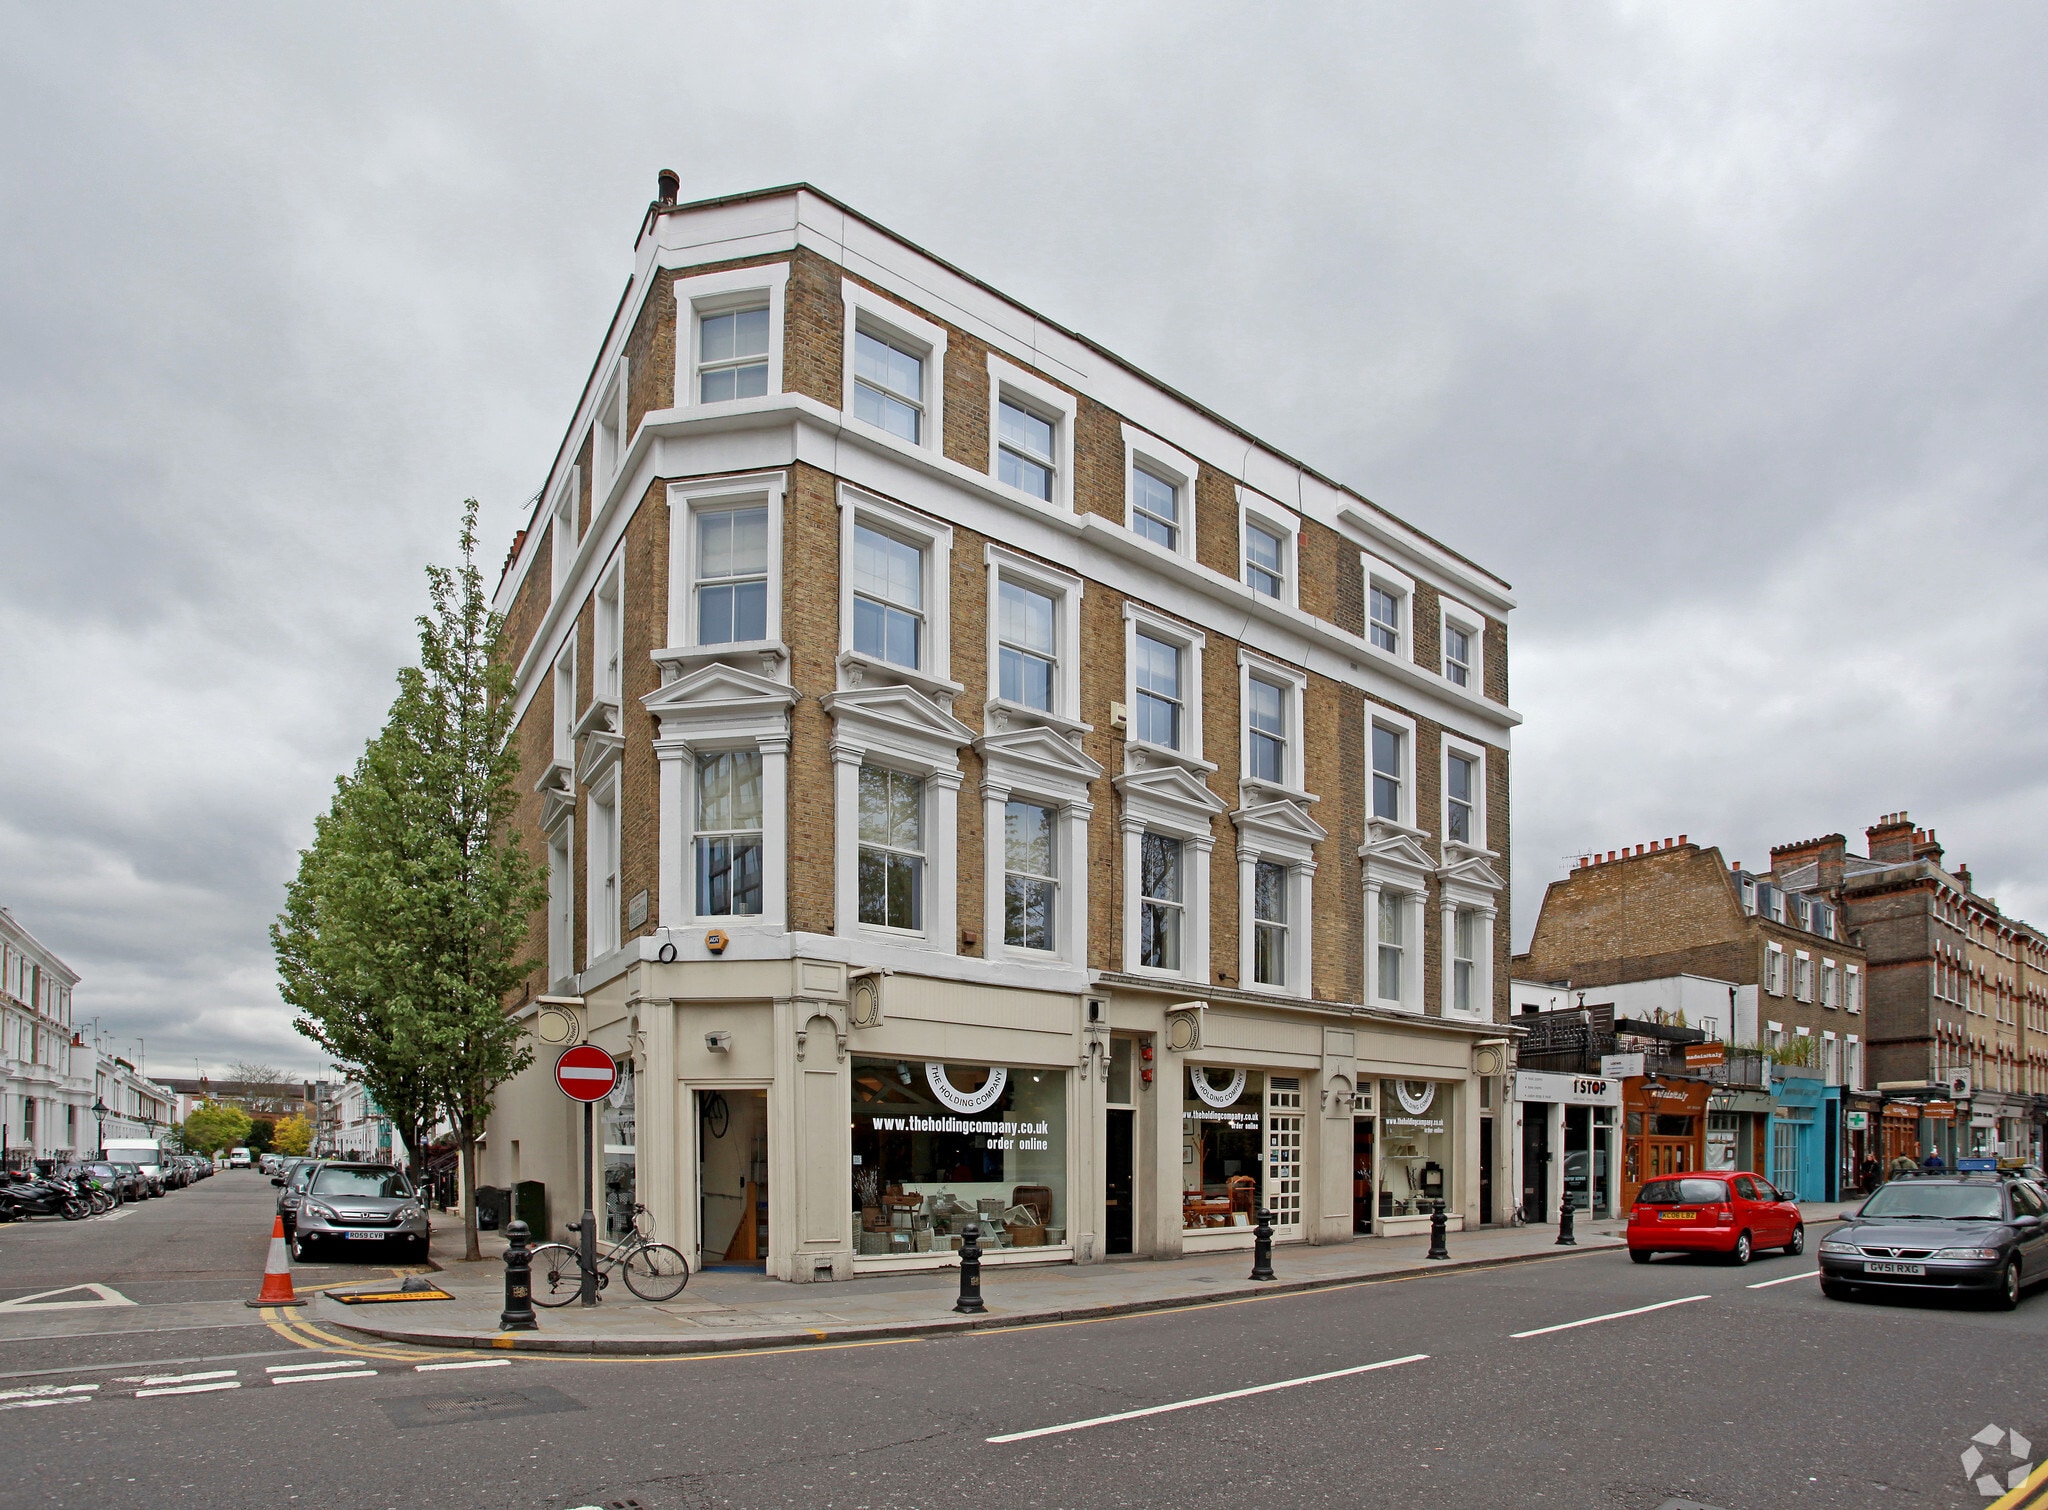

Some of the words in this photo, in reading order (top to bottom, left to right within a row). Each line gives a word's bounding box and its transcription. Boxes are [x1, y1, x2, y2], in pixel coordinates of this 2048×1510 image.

[931, 1065, 941, 1085] THE
[939, 1085, 974, 1107] HOLDING
[976, 1070, 1003, 1105] COMPANY
[1199, 1085, 1224, 1102] HOLDING
[1224, 1072, 1244, 1101] COMPANY
[1580, 1080, 1606, 1095] STOP
[1183, 1110, 1259, 1122] ww.theholdingcompany.co.uk
[872, 1115, 1048, 1137] www.theholdingcompany.co.uk
[987, 1137, 1014, 1150] order
[1019, 1137, 1048, 1150] online
[1663, 1211, 1680, 1219] KC06
[1681, 1211, 1695, 1219] LBZ
[1870, 1262, 1895, 1273] GV51
[1898, 1264, 1919, 1274] RXG
